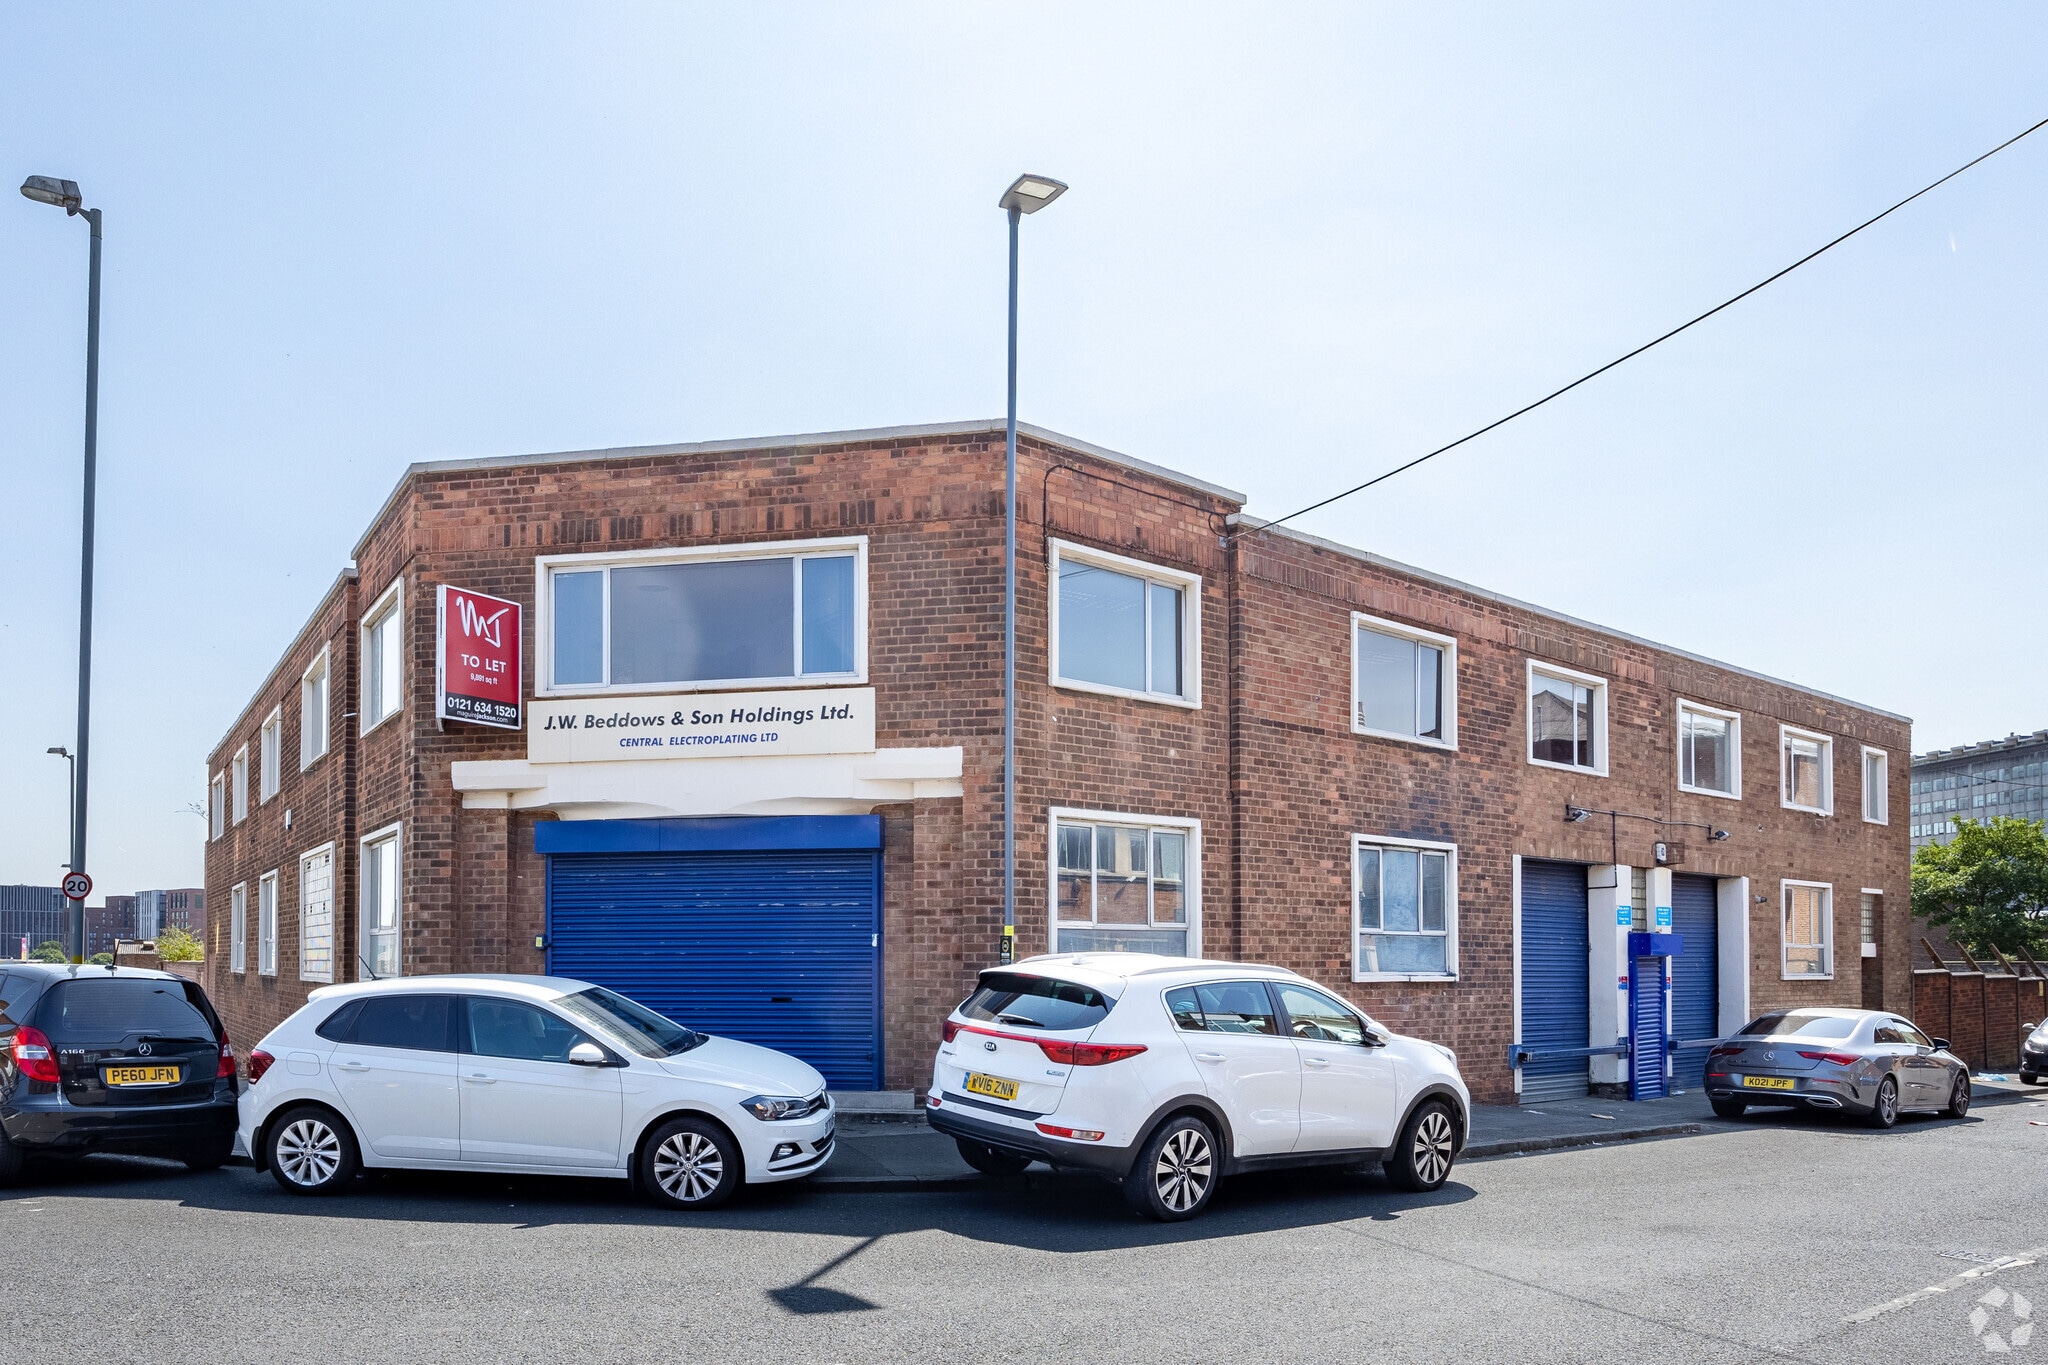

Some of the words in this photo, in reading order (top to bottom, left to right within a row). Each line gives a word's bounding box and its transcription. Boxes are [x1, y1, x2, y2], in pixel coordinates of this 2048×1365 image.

[461, 654, 480, 668] TO
[485, 658, 507, 673] LET
[485, 677, 492, 685] sq
[493, 677, 498, 685] ft
[447, 697, 471, 711] 0121
[474, 701, 492, 714] 634
[494, 705, 517, 718] 1520
[456, 710, 509, 723] maguirejackson.com
[544, 715, 578, 730] J.W.
[584, 712, 665, 729] Beddows
[671, 711, 684, 726] &
[690, 710, 724, 725] Son
[730, 706, 814, 725] Holdings
[820, 704, 854, 720] Ltd.
[619, 737, 664, 747] CENTRAL
[669, 733, 757, 746] ELECTROPLATING
[760, 732, 779, 743] LTD
[67, 880, 88, 892] 20
[985, 1042, 996, 1051] KIA
[112, 1069, 147, 1082] PE60
[150, 1068, 174, 1081] JFN
[994, 1080, 1015, 1097] ZNN
[1771, 1079, 1788, 1088] JPF
